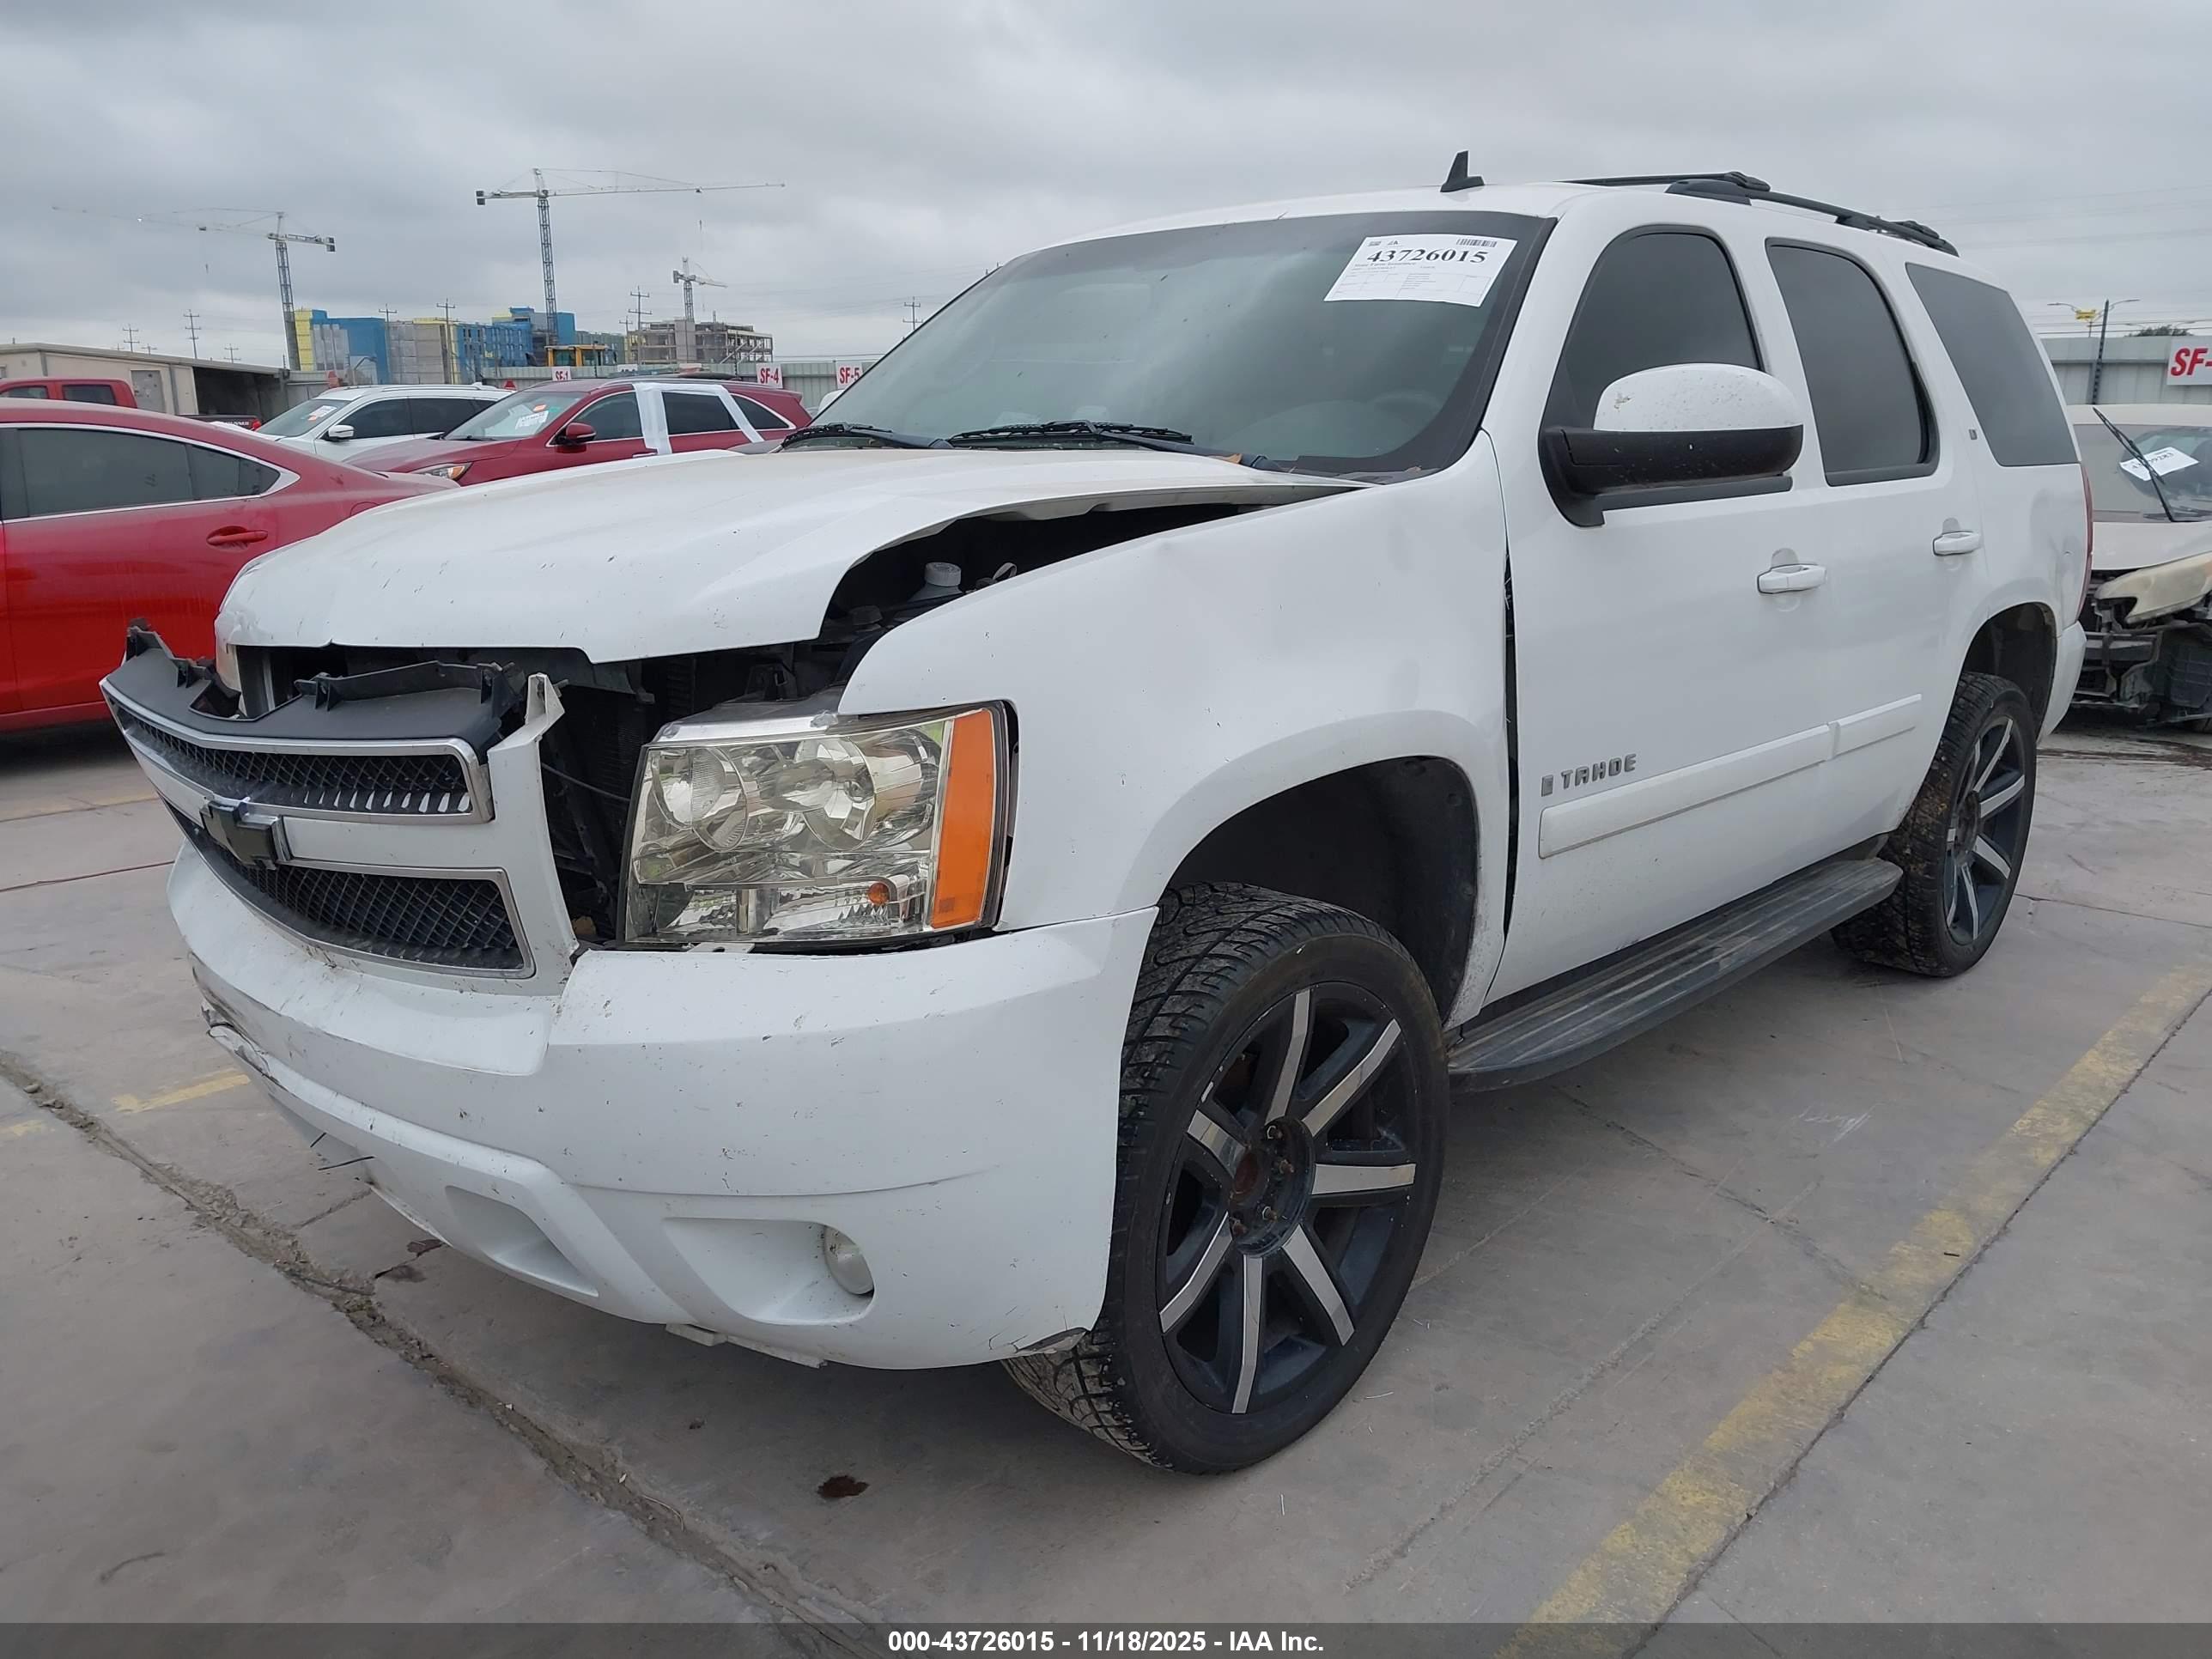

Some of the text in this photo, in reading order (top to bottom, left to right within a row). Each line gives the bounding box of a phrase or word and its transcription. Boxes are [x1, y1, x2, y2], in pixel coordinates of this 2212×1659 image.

[1367, 249, 1488, 263] 43726015
[760, 368, 780, 384] SF-4
[839, 367, 860, 384] SF-5
[1560, 753, 1637, 789] TAHOE
